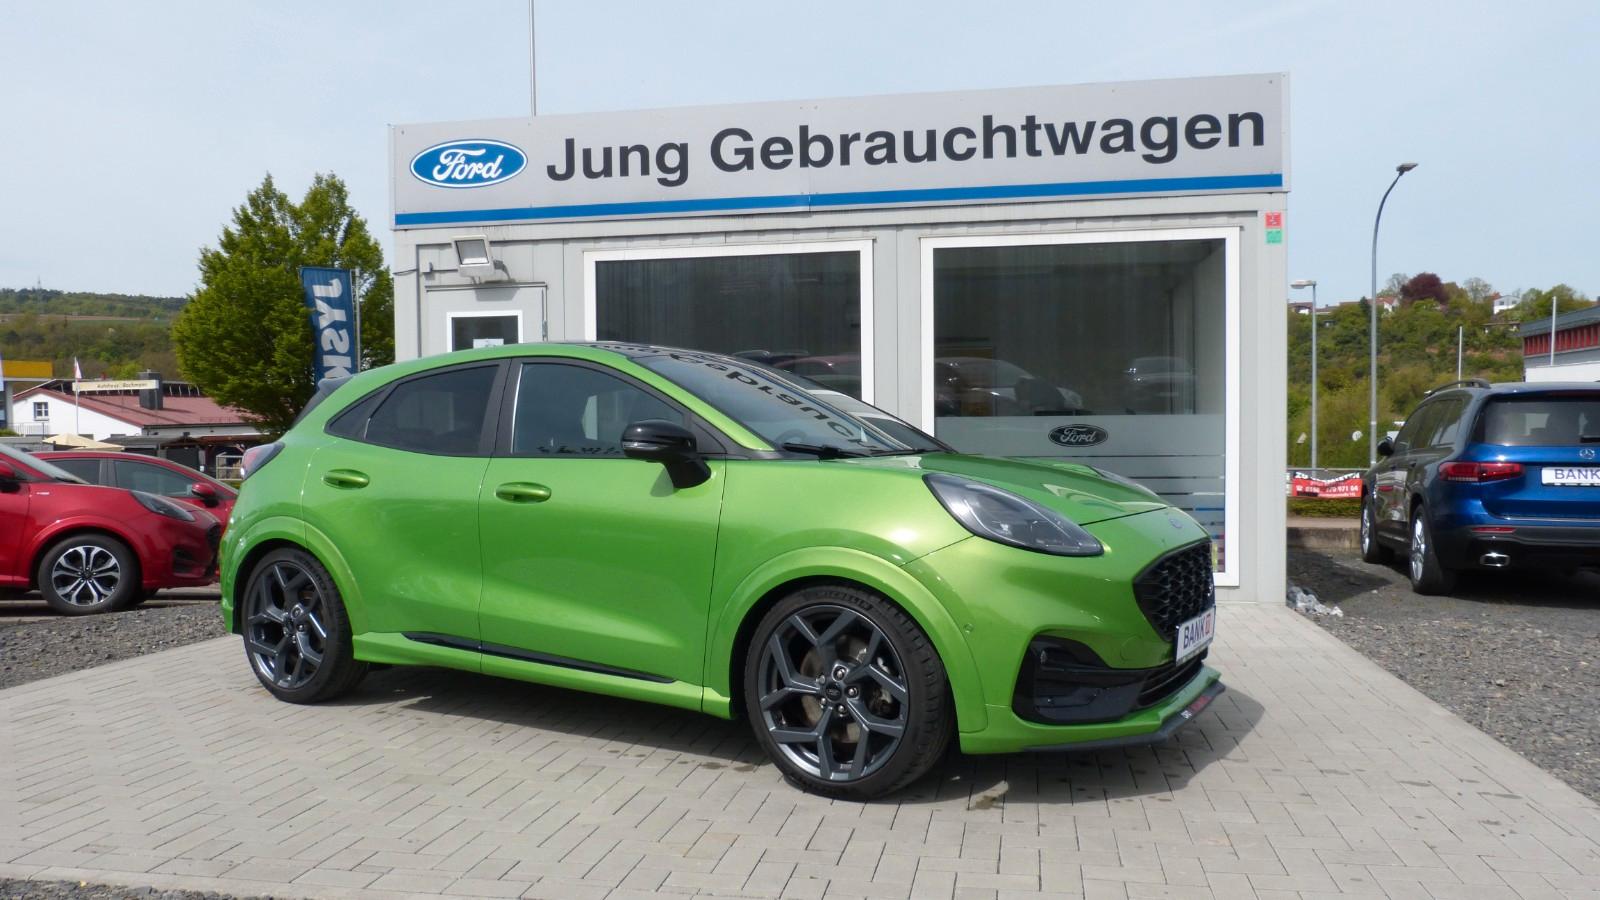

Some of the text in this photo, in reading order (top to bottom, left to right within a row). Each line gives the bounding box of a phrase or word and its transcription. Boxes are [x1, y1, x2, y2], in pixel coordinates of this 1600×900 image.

[546, 110, 1265, 187] Jung Gebrauchtwagen
[432, 148, 504, 181] Ford
[1060, 428, 1096, 442] Ford
[1554, 469, 1600, 479] BANK
